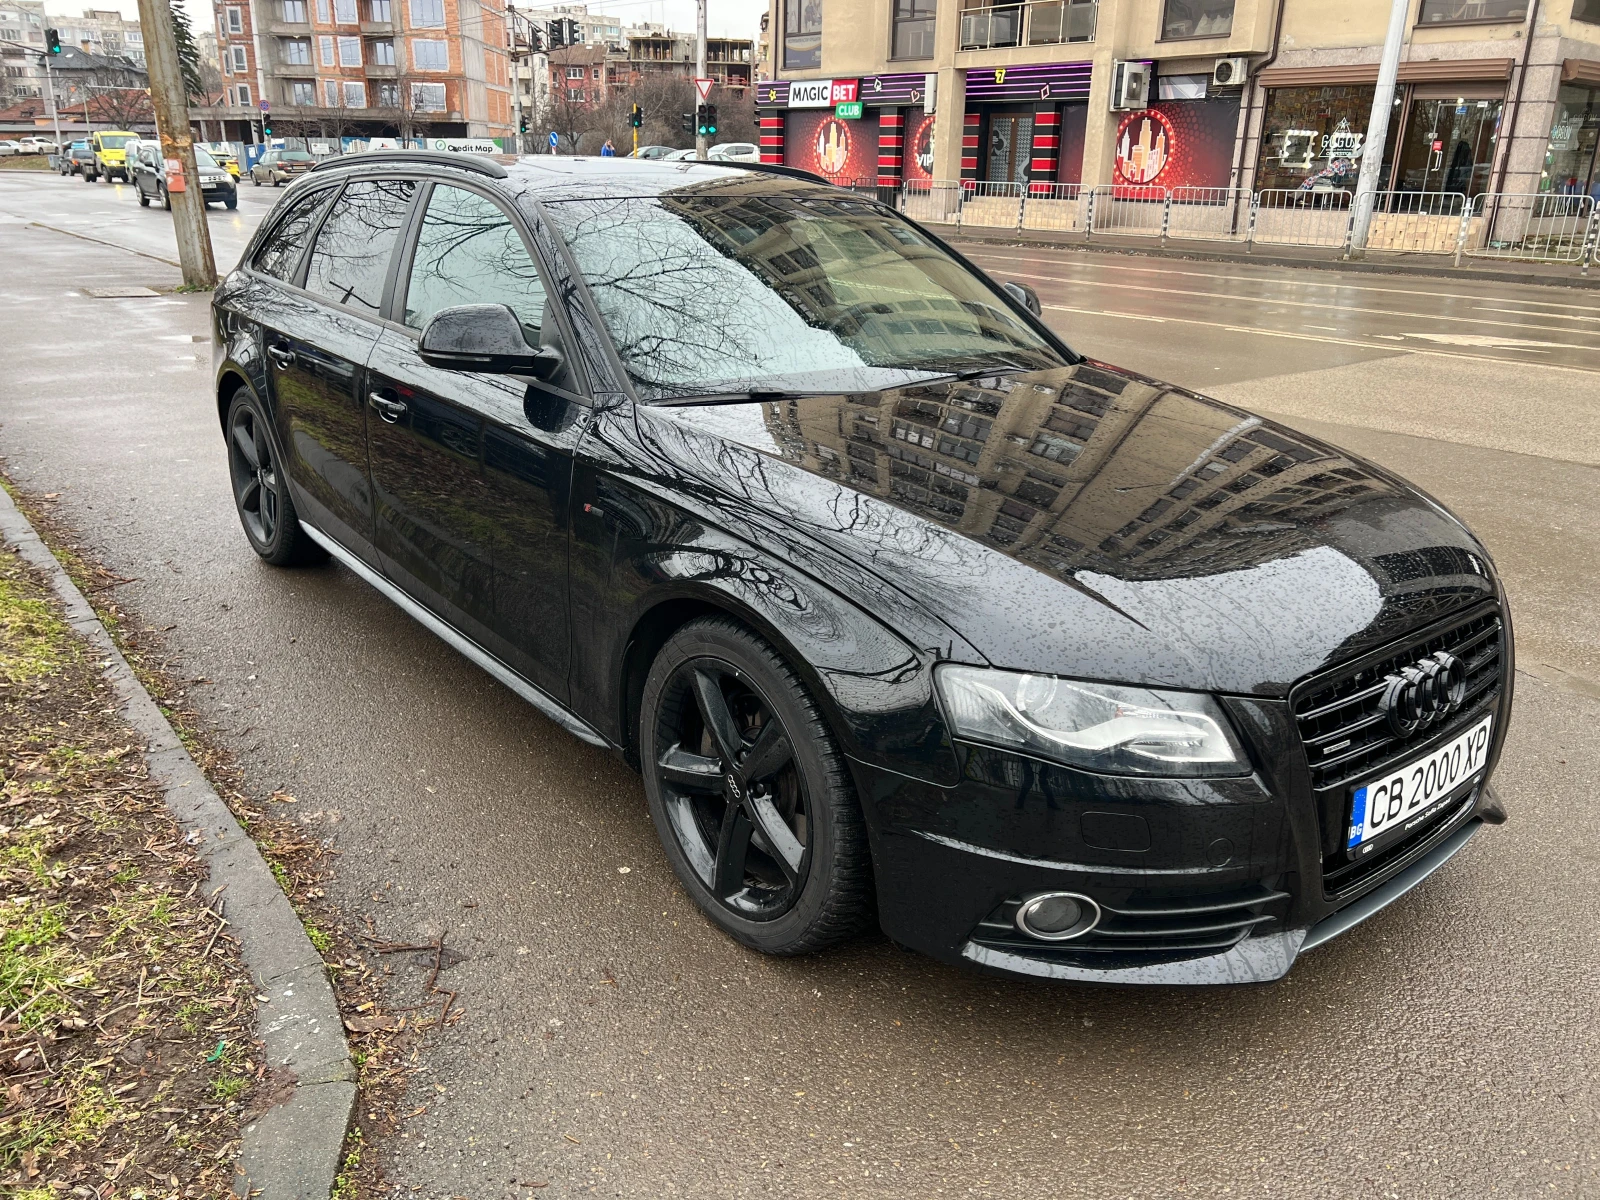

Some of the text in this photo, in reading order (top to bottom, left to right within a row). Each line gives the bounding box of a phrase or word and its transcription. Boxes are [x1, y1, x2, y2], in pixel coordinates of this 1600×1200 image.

[792, 84, 855, 102] MAGIC BET
[838, 105, 860, 116] CLUB
[447, 144, 493, 153] Cedit Map
[1370, 725, 1487, 829] CB 2000 XP
[1350, 823, 1363, 840] BG
